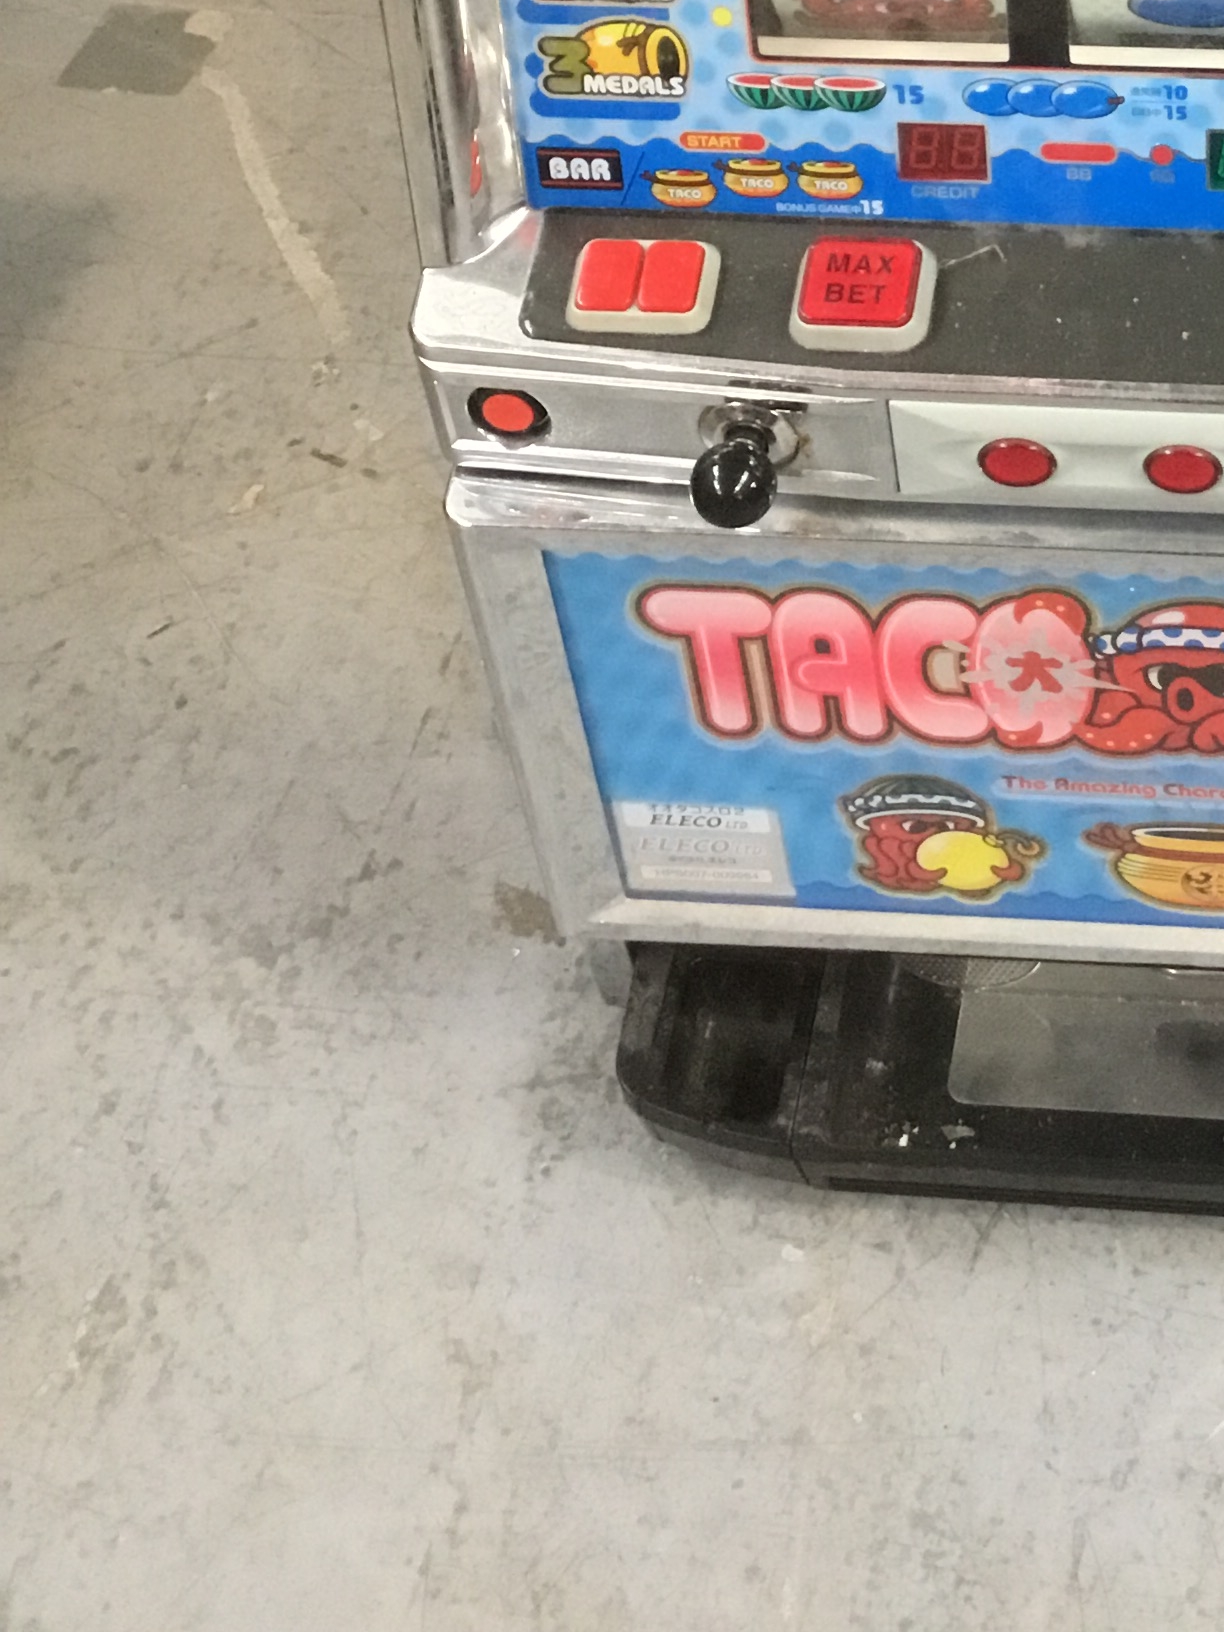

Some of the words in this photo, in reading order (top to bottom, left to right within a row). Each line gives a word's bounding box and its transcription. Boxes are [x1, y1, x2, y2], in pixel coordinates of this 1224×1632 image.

[583, 74, 685, 96] MEDALS
[1163, 85, 1188, 100] 10
[892, 84, 924, 105] 15
[1164, 105, 1187, 120] 15
[685, 135, 742, 149] START
[548, 157, 612, 182] BAR
[739, 176, 775, 189] TACO
[813, 178, 849, 191] TACO
[666, 187, 703, 200] TACO
[911, 185, 980, 200] CREDIT
[775, 202, 816, 213] BONUS
[825, 252, 895, 275] MAX
[824, 284, 886, 305] BET
[636, 582, 1097, 750] TACO
[1001, 774, 1047, 792] The
[1054, 776, 1158, 799] Amazing
[650, 813, 722, 829] ELECO
[725, 820, 748, 830] LTD
[641, 837, 730, 854] ELECO
